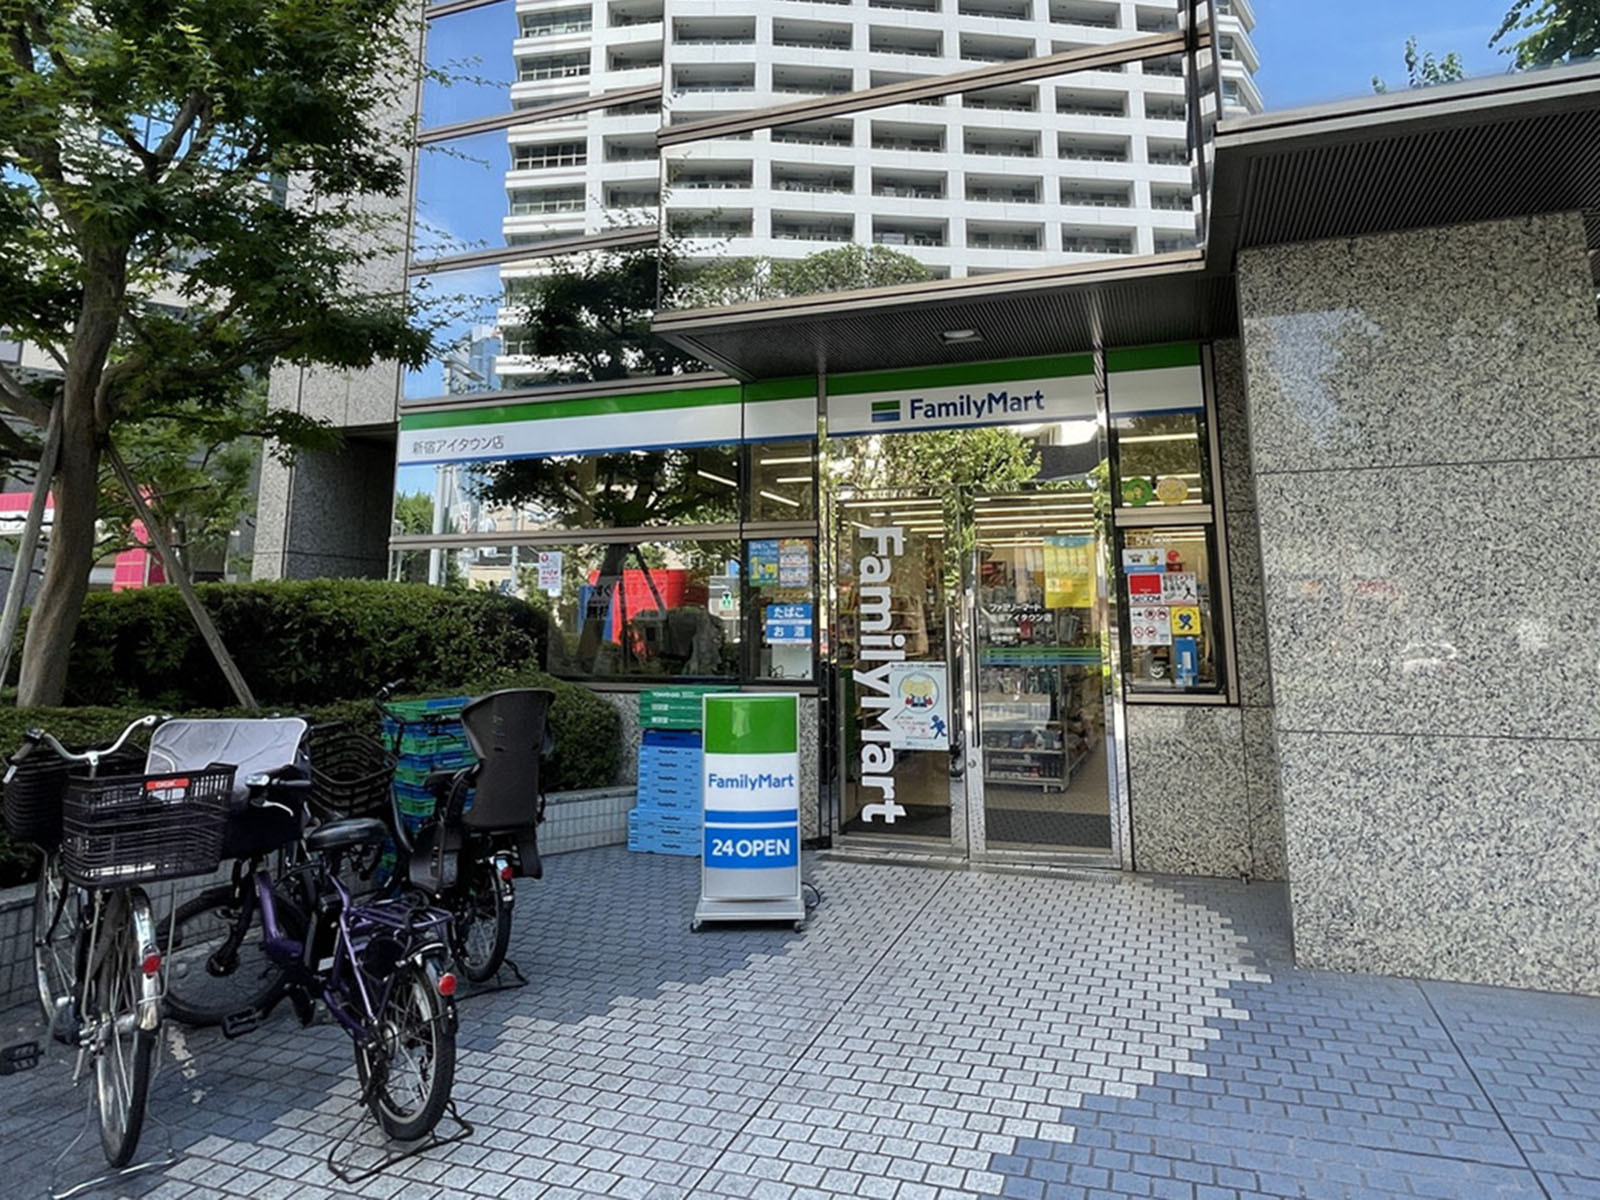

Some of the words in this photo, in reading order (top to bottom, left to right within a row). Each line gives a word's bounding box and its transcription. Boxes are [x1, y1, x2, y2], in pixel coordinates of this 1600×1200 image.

[909, 390, 1045, 420] FamilyMart
[412, 435, 505, 454] 新宿アイタウン店
[773, 607, 805, 618] たばこ
[853, 527, 907, 824] FamilyMart
[708, 773, 794, 791] FamilyMart
